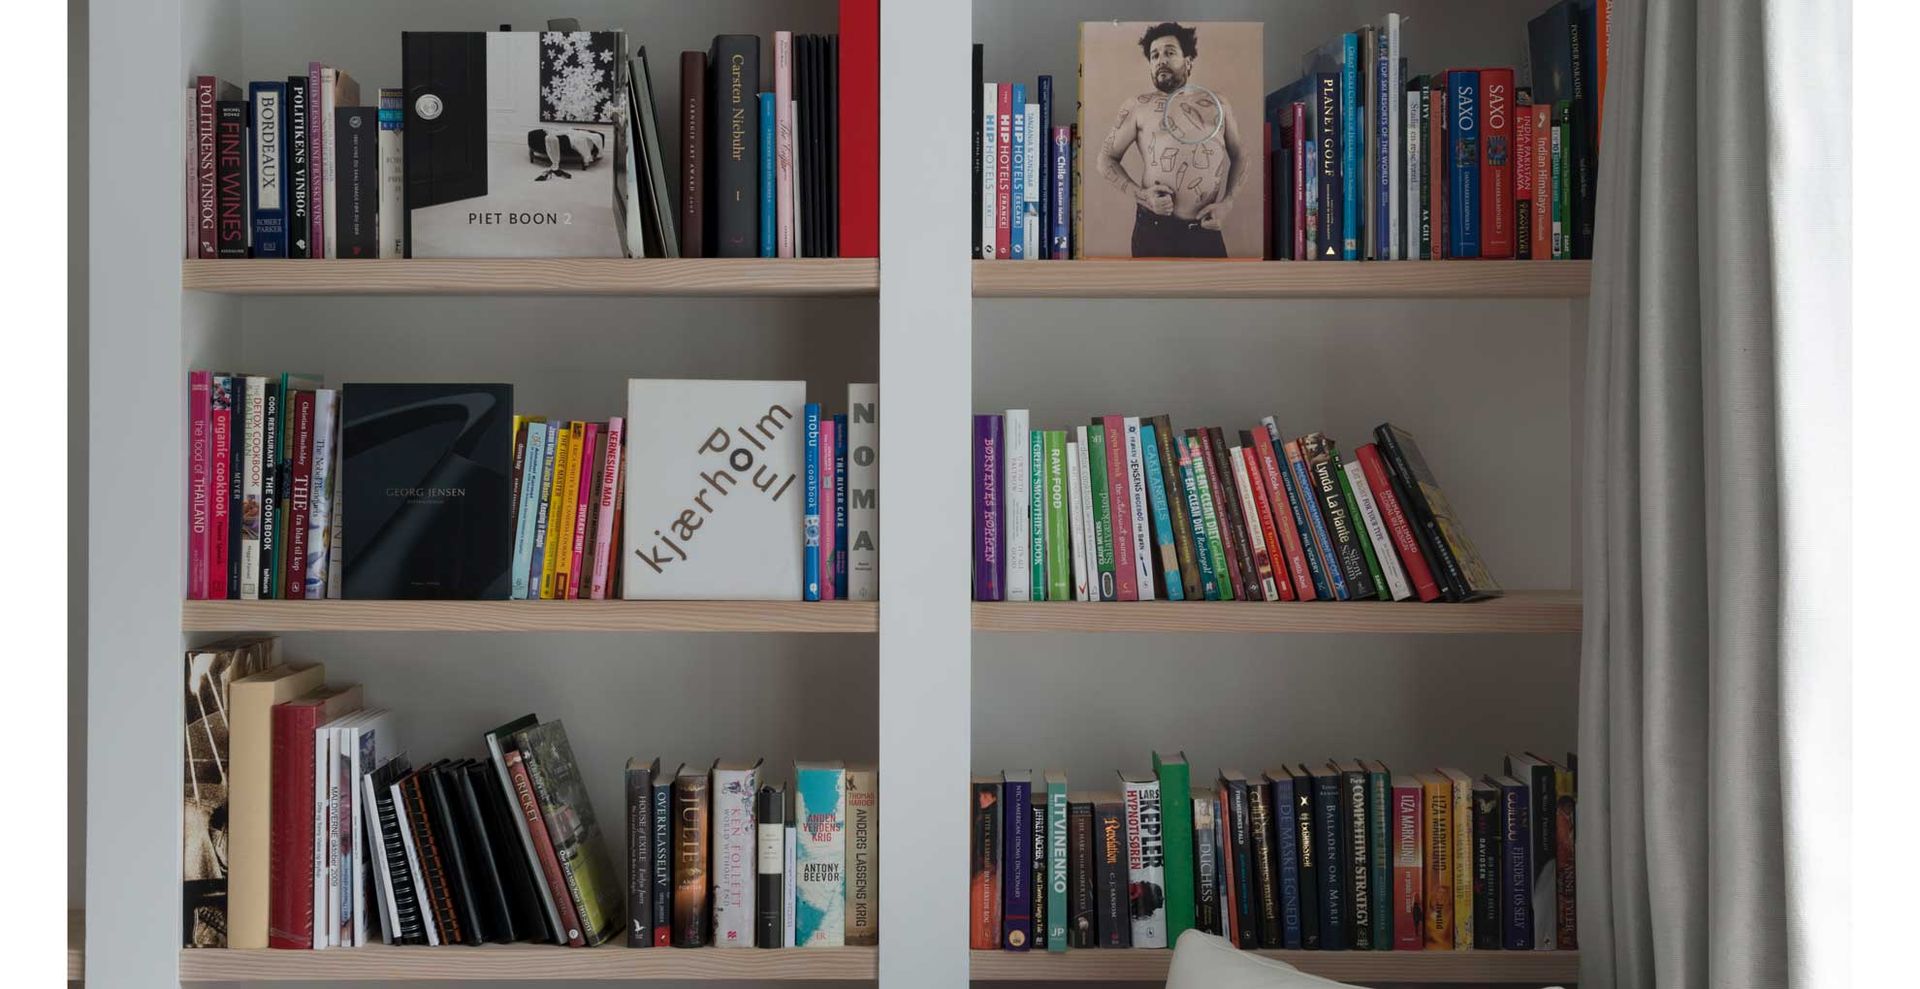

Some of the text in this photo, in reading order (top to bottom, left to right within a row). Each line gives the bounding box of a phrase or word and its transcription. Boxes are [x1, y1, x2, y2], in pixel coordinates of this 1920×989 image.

[1570, 24, 1582, 100] POWDER PARADISE
[732, 55, 746, 160] Carsten Niebuhr
[1000, 114, 1010, 142] HIP
[1014, 114, 1024, 142] HIP
[1324, 79, 1334, 134] PLANET
[1382, 126, 1388, 138] OF
[1458, 86, 1473, 130] SAXO
[1490, 84, 1504, 128] SAXO
[200, 85, 213, 229] POLITIKENS VINBOG
[262, 97, 276, 188] BORDEAUX
[294, 86, 306, 217] POLITIKENS VINBOG
[1000, 145, 1010, 190] HOTELS
[1014, 145, 1024, 190] HOTELS
[1057, 156, 1065, 180] Chile
[1325, 138, 1334, 176] GOLF
[221, 122, 241, 241] FINE WINES
[1537, 138, 1548, 214] Indian Himalaya
[469, 213, 572, 224] PIET BOON 2
[215, 416, 228, 457] organic
[252, 398, 262, 486] DETOX COOKBOOK
[516, 444, 524, 460] donna
[532, 448, 540, 475] Annabel
[556, 434, 568, 496] THE JUICE MASTER
[808, 415, 818, 508] nobu cookbook
[193, 420, 204, 534] the food of THAILAND
[216, 462, 227, 516] cookbook
[264, 396, 276, 550] COOL RESTAURANTS THE COOKBOOK
[292, 402, 309, 570] Christian THE fra blad til kop
[311, 440, 324, 517] The Nobel Banquets
[386, 488, 466, 497] GEORG JENSEN
[602, 430, 618, 506] KERNESUND MAD
[634, 404, 793, 574] kjærholm
[853, 403, 875, 551] NOMA
[1052, 448, 1061, 508] RAW FOOD
[1130, 460, 1142, 493] JENSENS
[1147, 444, 1168, 521] CAKE ANGELS
[1192, 457, 1220, 540] THE EAT-CLEAN DIET
[536, 502, 550, 548] Keeping Simple
[575, 504, 588, 554] SUVERÆNT SUNDT
[984, 437, 996, 563] BØRNENES KØKKEN
[1032, 444, 1042, 566] GREEN SMOOTHIES BOOK
[1185, 478, 1204, 536] EAT-CLEAN DIET
[1316, 462, 1351, 543] Lynda La Plante
[1362, 498, 1383, 540] FOR TYPE
[1380, 492, 1410, 551] GLOBAL DESIGN
[1385, 490, 1405, 524] DENMARK
[1400, 526, 1417, 553] LIMITED
[1118, 536, 1127, 565] gourmet
[1293, 506, 1319, 574] BAKING PHIL VICKERY
[1340, 544, 1358, 580] Scream
[1350, 548, 1362, 576] Silent
[515, 774, 538, 822] CRICKET
[808, 814, 836, 822] ANDEN
[1139, 790, 1160, 799] LARS
[330, 786, 338, 886] MALDIVERNE oktober 2009
[638, 796, 646, 862] HOUSE EXILE
[656, 792, 666, 886] OVERKLASSELIV
[680, 798, 700, 863] JULIE
[731, 808, 740, 908] KEN FOLLETT
[803, 823, 840, 832] VERDENS
[812, 832, 832, 842] KRIG
[1033, 808, 1044, 860] JEFFREY ARCHER
[1054, 793, 1066, 894] LITVINENKO
[1104, 817, 1120, 864] Revelation
[1127, 790, 1141, 870] HYPNOTISØREN
[1140, 800, 1164, 868] KEPLER
[1352, 785, 1368, 926] COMPETITIVE STRATEGY
[1401, 795, 1414, 864] LIZA MARKLUND
[1432, 796, 1446, 870] LIZA MARKLUND
[560, 850, 581, 903] Our First Years
[804, 864, 838, 872] ANTONY
[804, 874, 840, 882] BEEVOR
[856, 809, 867, 926] ANDERS LASSENS KRIG
[1200, 844, 1212, 902] DUCHESS
[1280, 805, 1298, 931] DE MÅSKE EGNEDE
[1326, 805, 1340, 925] BALLADEN OM MARIE
[1512, 848, 1526, 928] FJENDEN OS SELV
[1264, 884, 1274, 919] marked
[1564, 864, 1576, 932] ANNE TYLER
[1052, 928, 1064, 936] JP
